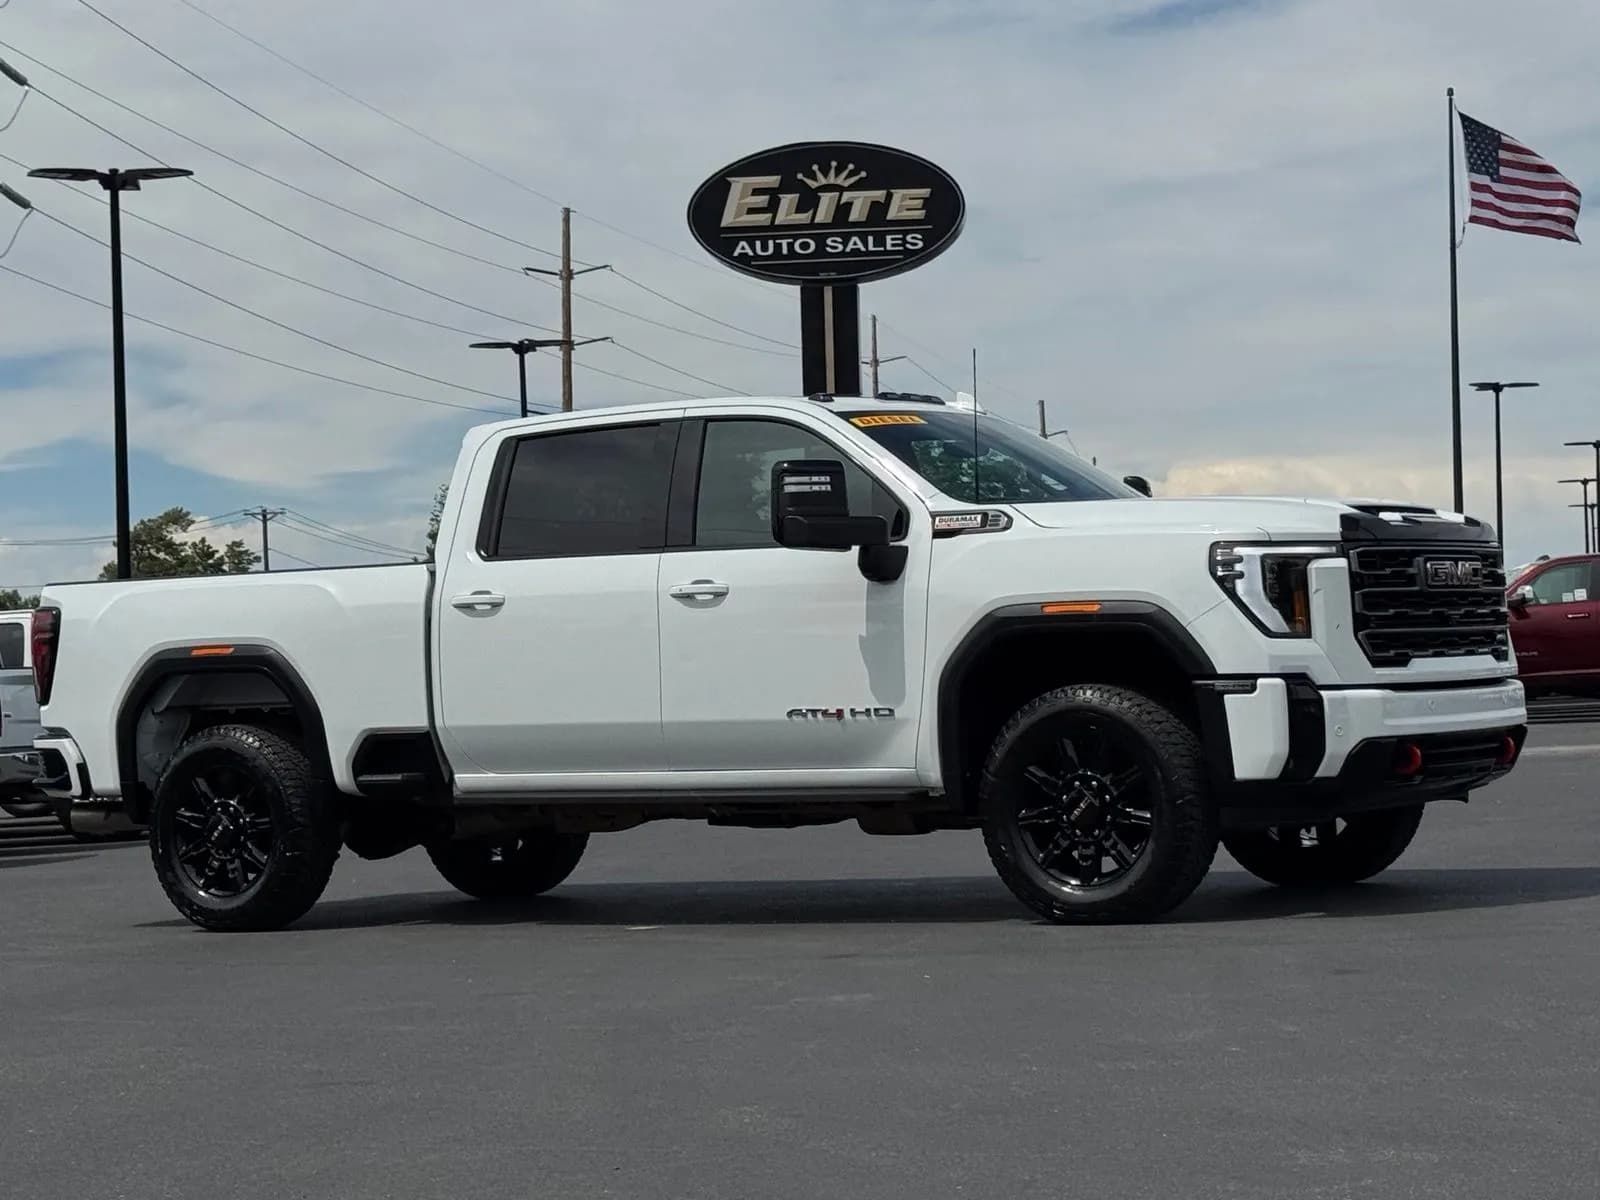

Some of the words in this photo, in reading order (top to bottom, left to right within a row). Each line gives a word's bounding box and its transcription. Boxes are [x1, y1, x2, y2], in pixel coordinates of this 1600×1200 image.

[733, 238, 816, 257] AUTO
[825, 233, 924, 253] SALES
[857, 416, 921, 425] DIESEL
[938, 515, 979, 524] DURAMAX
[1426, 561, 1482, 586] GMC
[786, 708, 843, 721] AT4
[849, 708, 895, 719] HD
